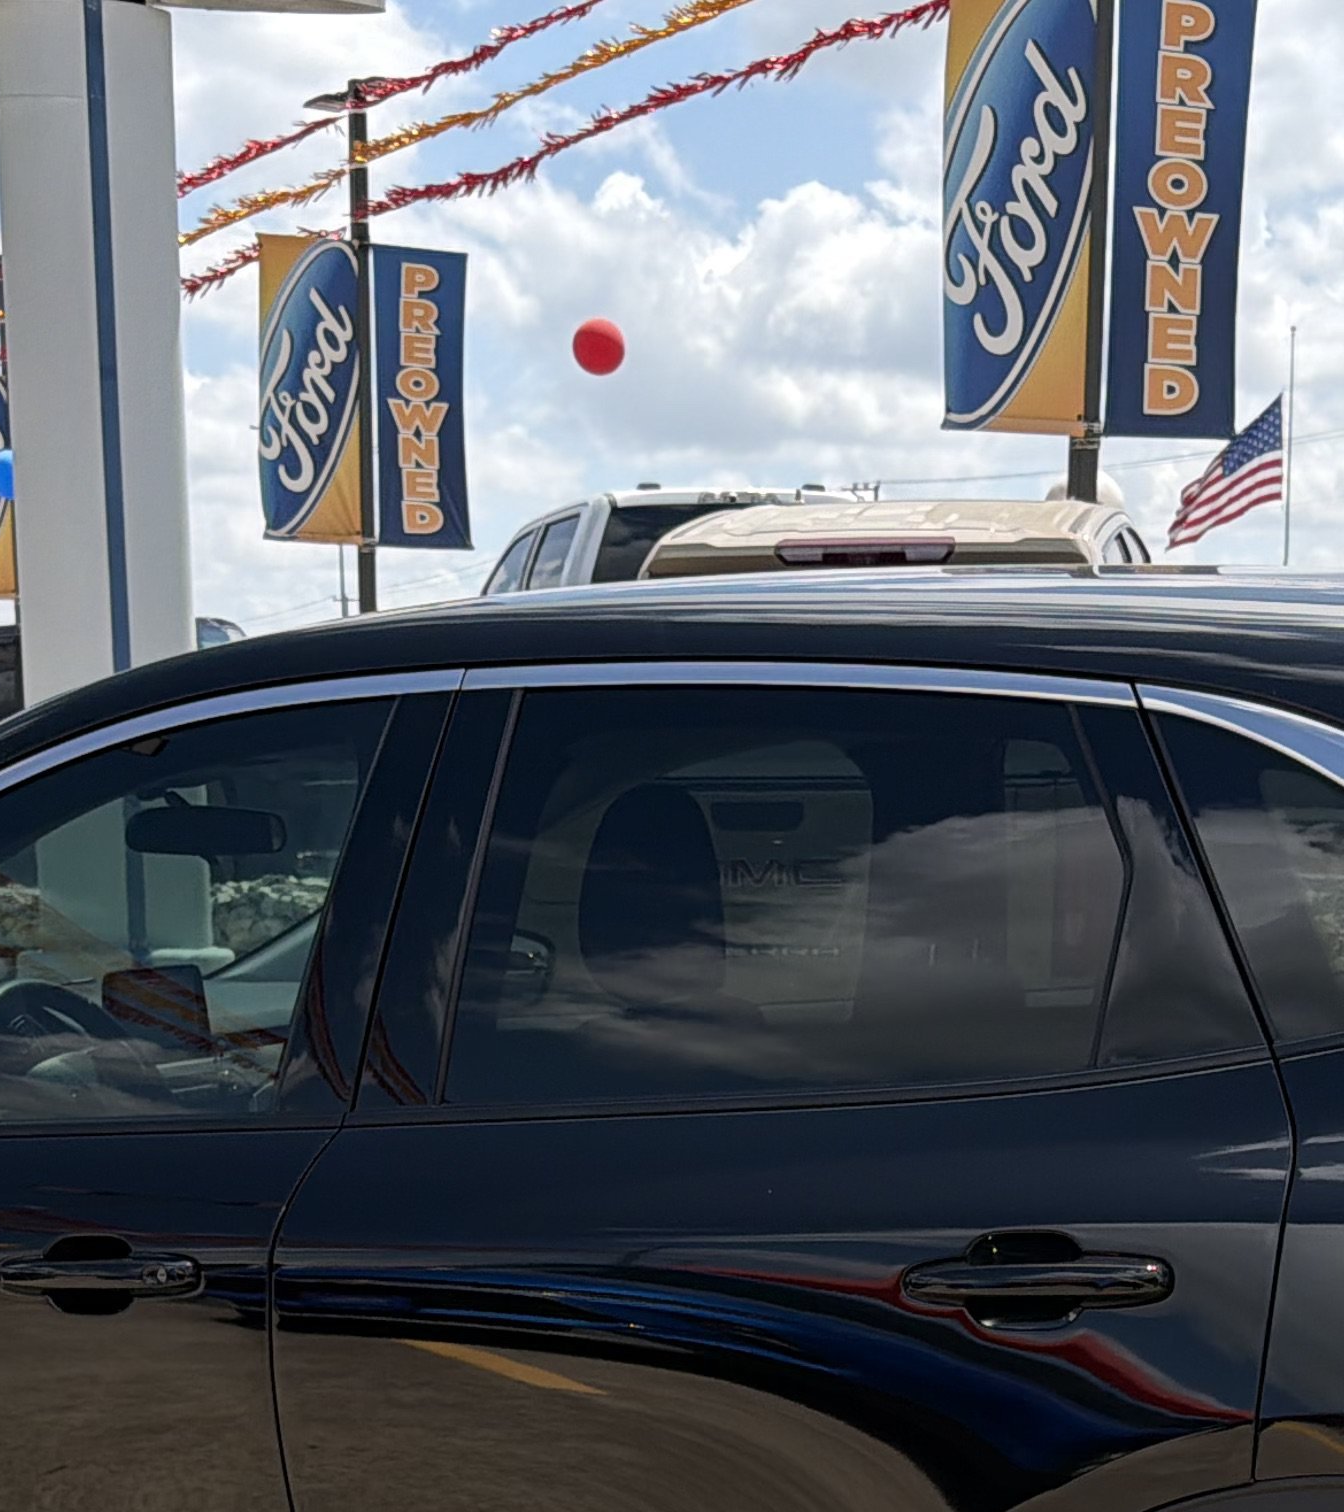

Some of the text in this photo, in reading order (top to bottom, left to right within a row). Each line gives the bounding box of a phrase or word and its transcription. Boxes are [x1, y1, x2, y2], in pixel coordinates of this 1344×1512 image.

[946, 38, 1087, 355] Ford
[1133, 0, 1219, 416] PREOWNED
[259, 287, 353, 493] Ford
[388, 261, 449, 535] PREOWNED
